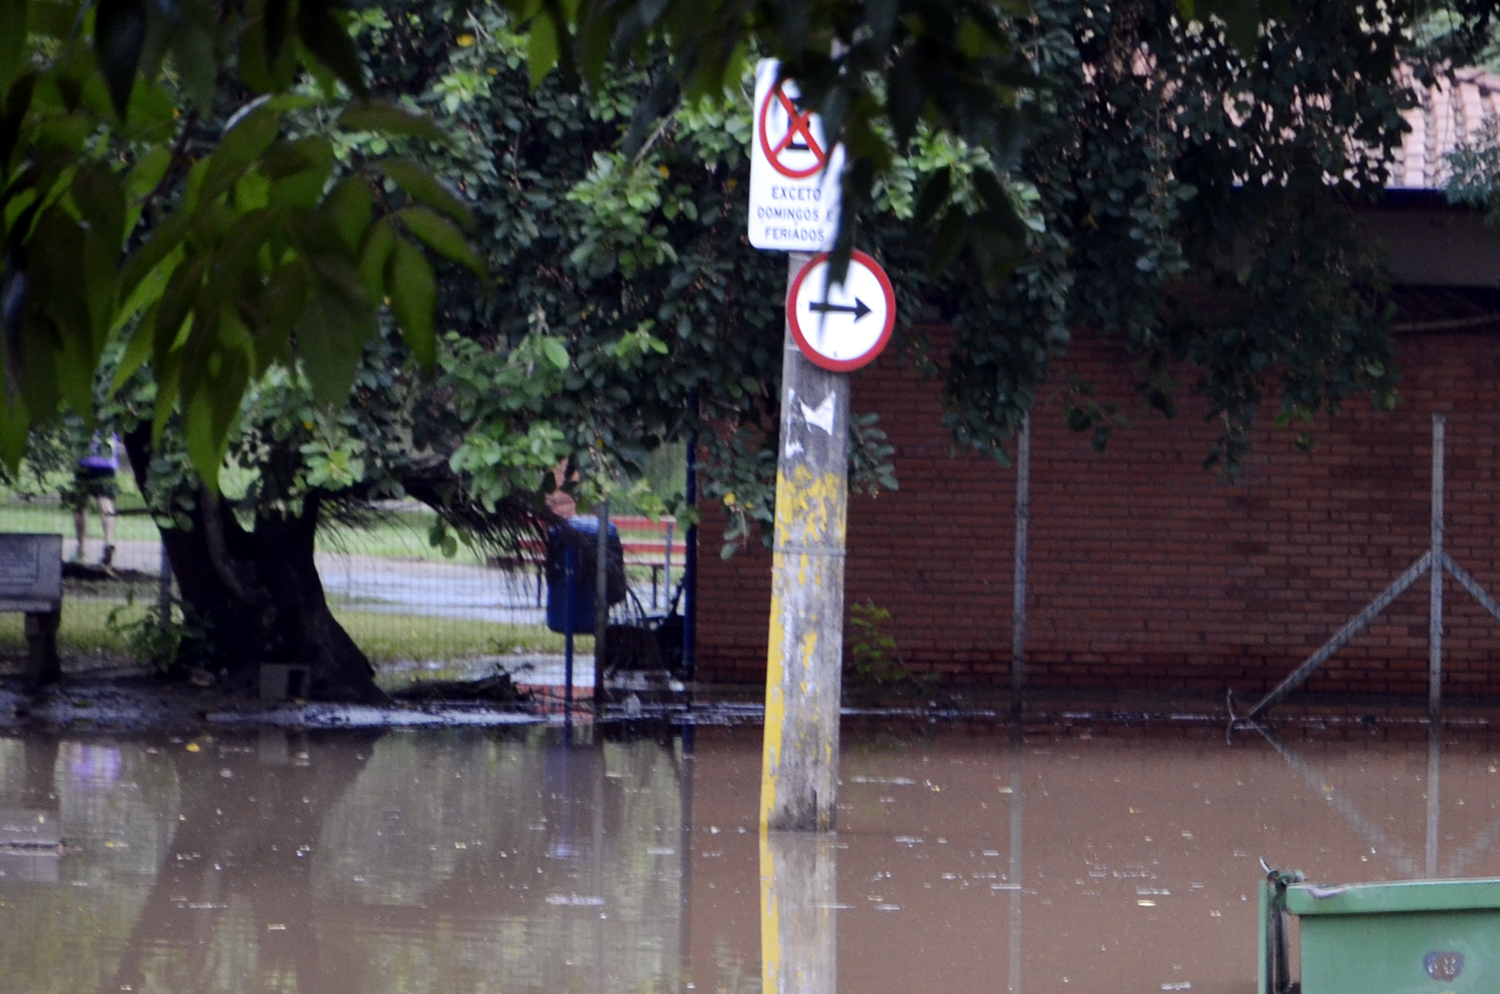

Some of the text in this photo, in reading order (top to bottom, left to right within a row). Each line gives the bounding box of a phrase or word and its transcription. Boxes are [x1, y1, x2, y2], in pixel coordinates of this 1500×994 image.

[771, 186, 821, 201] EXCETO
[757, 206, 834, 222] DOMINGOS E
[765, 227, 825, 242] FERIADOS
